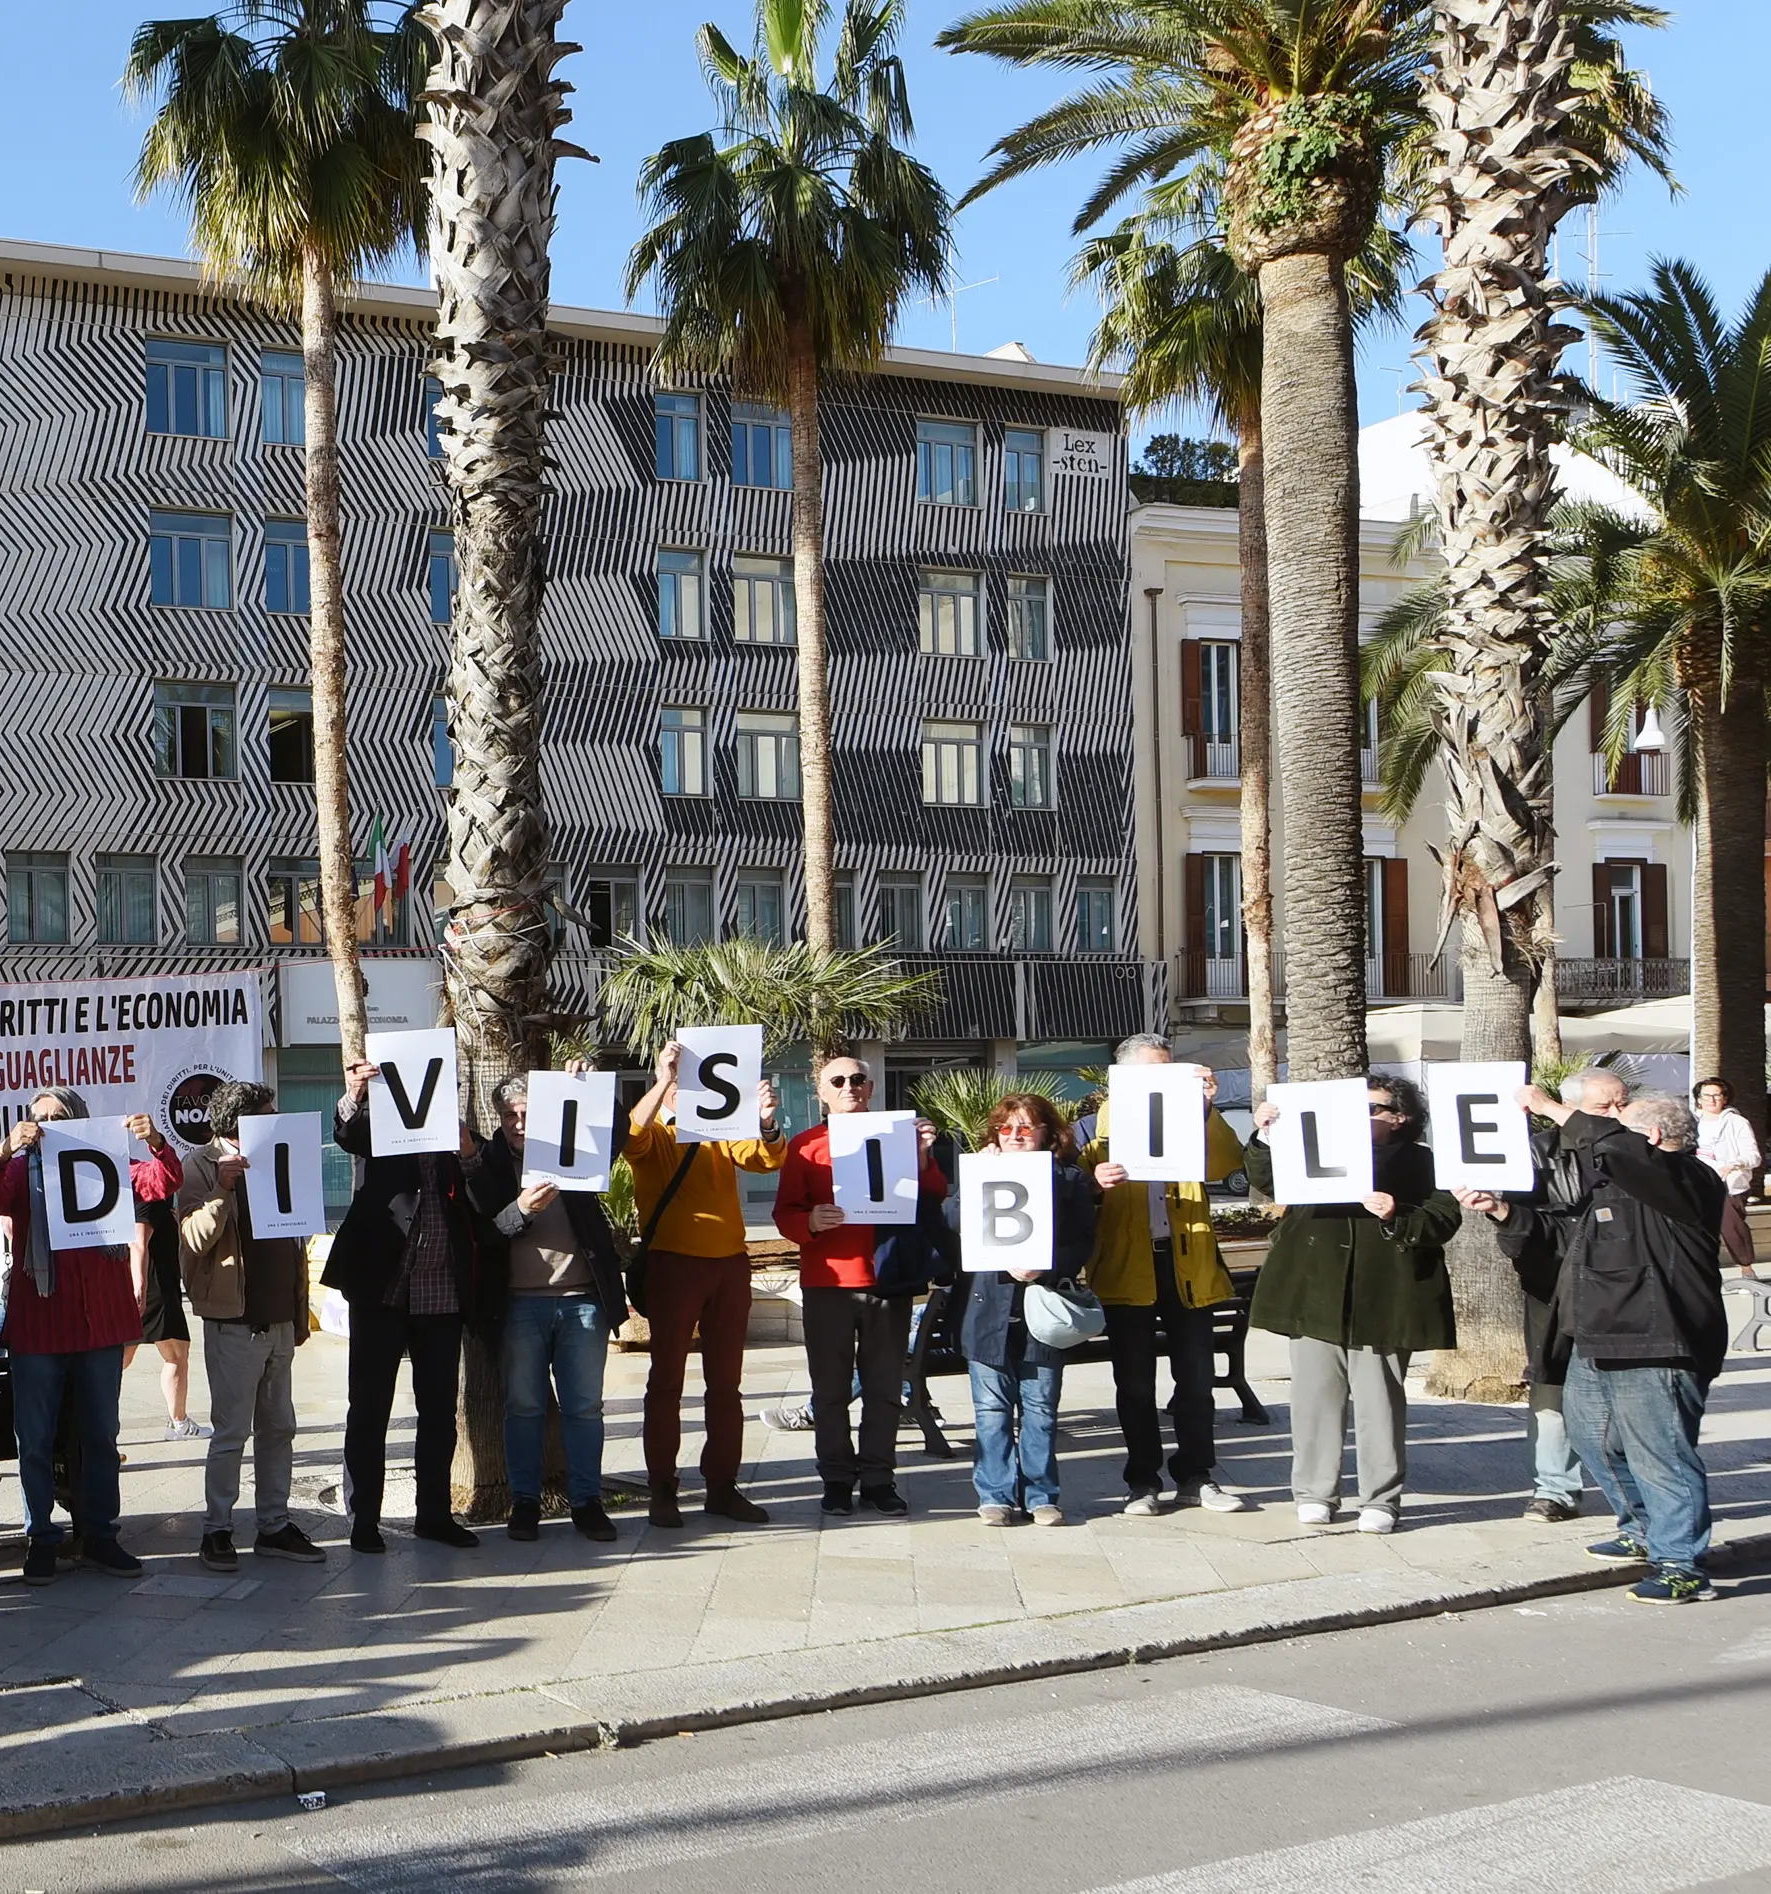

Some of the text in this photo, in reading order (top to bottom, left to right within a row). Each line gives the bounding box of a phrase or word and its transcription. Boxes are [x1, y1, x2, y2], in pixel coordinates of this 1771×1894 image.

[1063, 433, 1096, 454] Lex
[75, 996, 90, 1033] E
[96, 988, 249, 1032] L'ECONOMIA
[160, 1091, 170, 1105] DEI
[193, 1063, 208, 1071] PER
[175, 1094, 212, 1107] TAVO
[379, 1057, 443, 1129] V
[696, 1052, 741, 1121] S
[559, 1099, 578, 1168] I
[1149, 1092, 1164, 1158] I
[1300, 1110, 1345, 1179] L
[1456, 1094, 1507, 1165] E
[57, 1149, 120, 1224] D
[274, 1142, 293, 1214] I
[865, 1138, 885, 1203] I
[982, 1181, 1033, 1246] B
